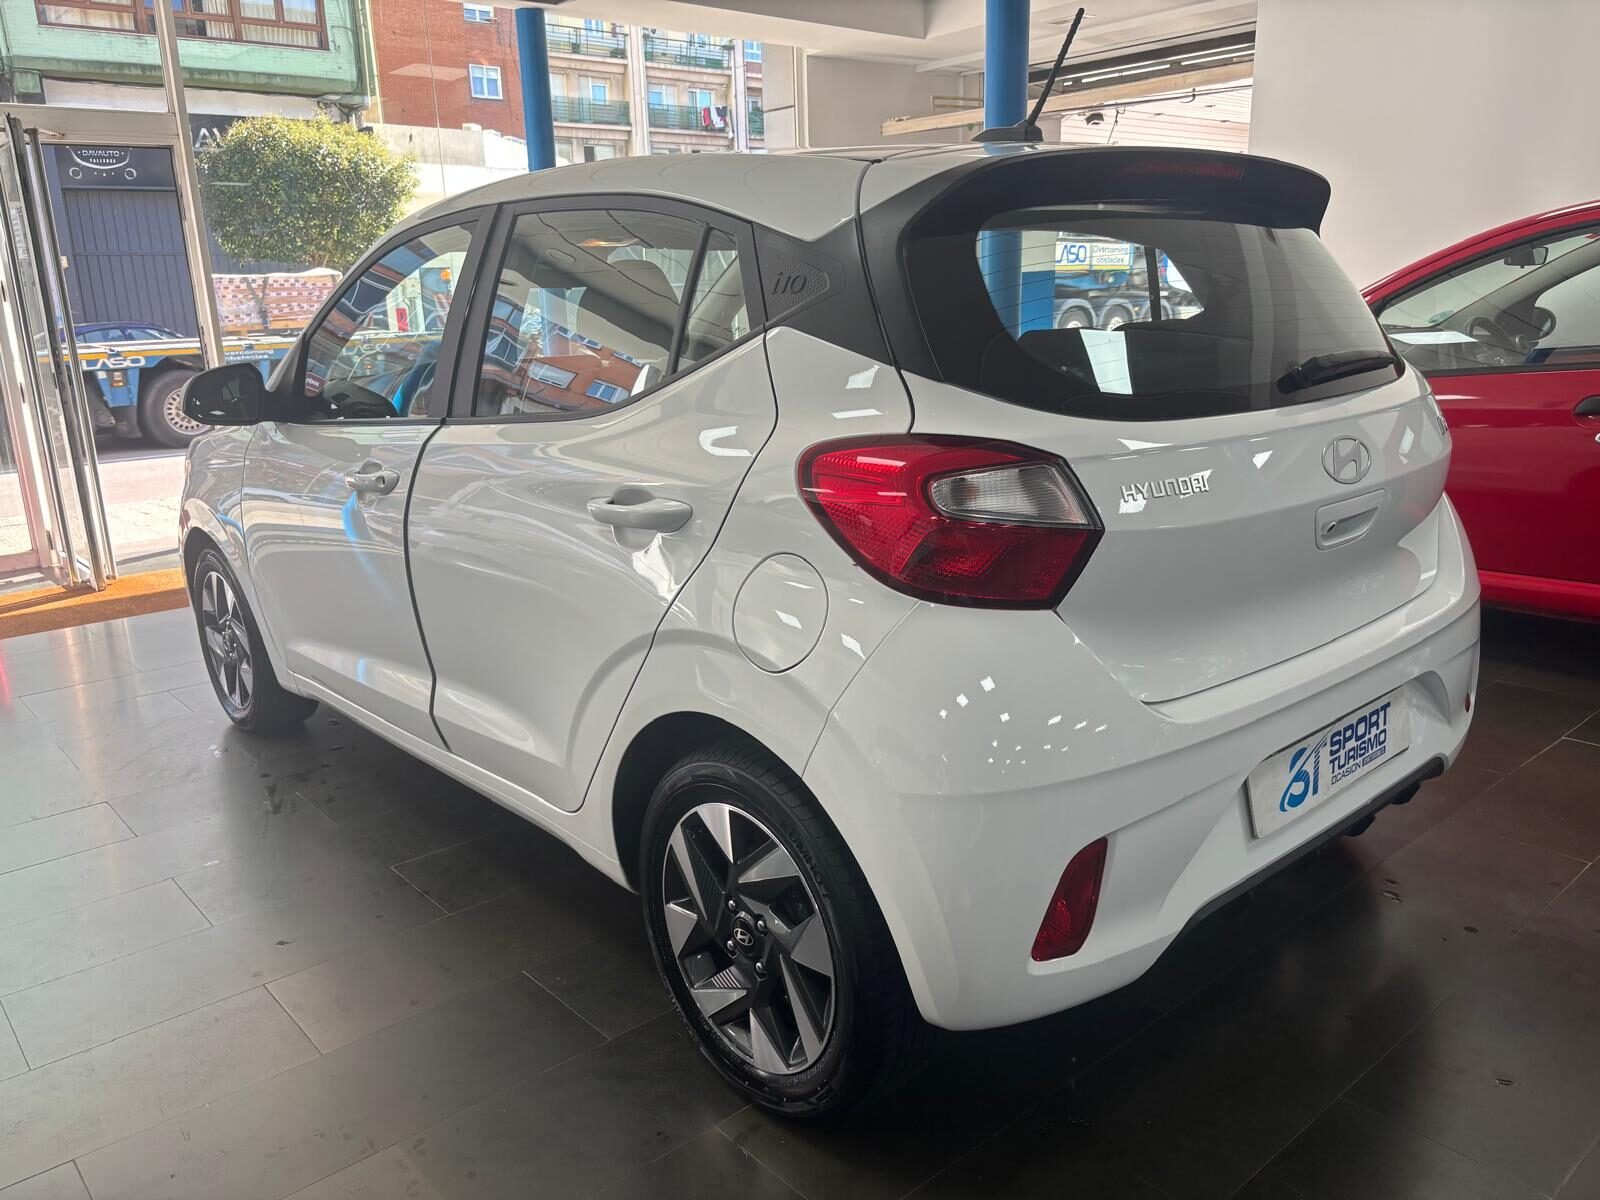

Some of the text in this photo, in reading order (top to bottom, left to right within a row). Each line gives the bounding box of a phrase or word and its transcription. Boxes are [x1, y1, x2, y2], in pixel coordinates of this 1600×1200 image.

[771, 271, 807, 295] i10
[1120, 473, 1210, 503] HYUNDAI
[1329, 701, 1391, 757] SPORT
[1329, 728, 1387, 774] TURISMO
[1331, 759, 1362, 785] OCASION
